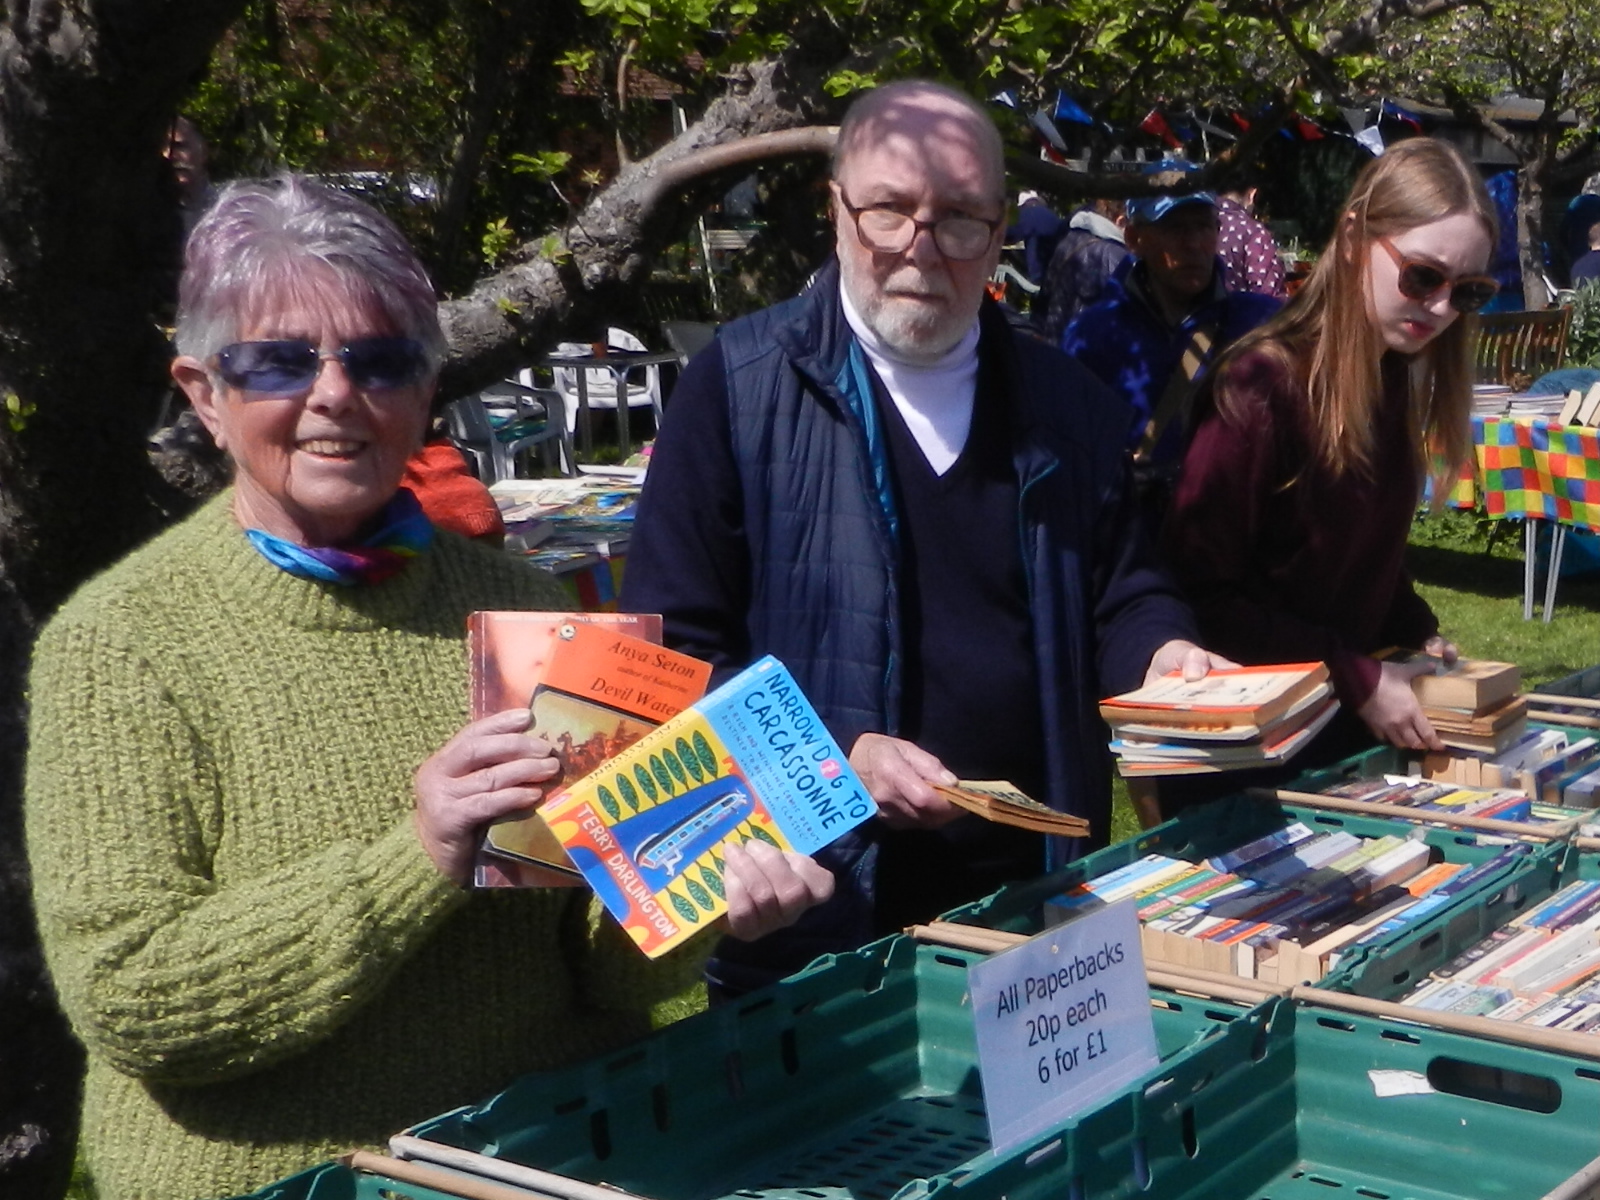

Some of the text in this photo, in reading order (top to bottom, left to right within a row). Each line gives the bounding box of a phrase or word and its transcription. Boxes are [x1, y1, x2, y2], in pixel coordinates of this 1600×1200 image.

[590, 677, 634, 701] Devil
[608, 640, 696, 678] Anya Seton
[744, 691, 846, 830] CARCASSONNE
[745, 733, 758, 749] AND
[756, 749, 785, 788] WINNING
[782, 788, 801, 814] COMIC
[764, 673, 823, 746] NARROW
[844, 790, 868, 819] TO
[578, 803, 678, 938] TERRY DARLINGTON
[997, 943, 1124, 1018] All Paperbacks
[1025, 989, 1107, 1047] 20p each
[1038, 1029, 1107, 1084] 6 for £1
